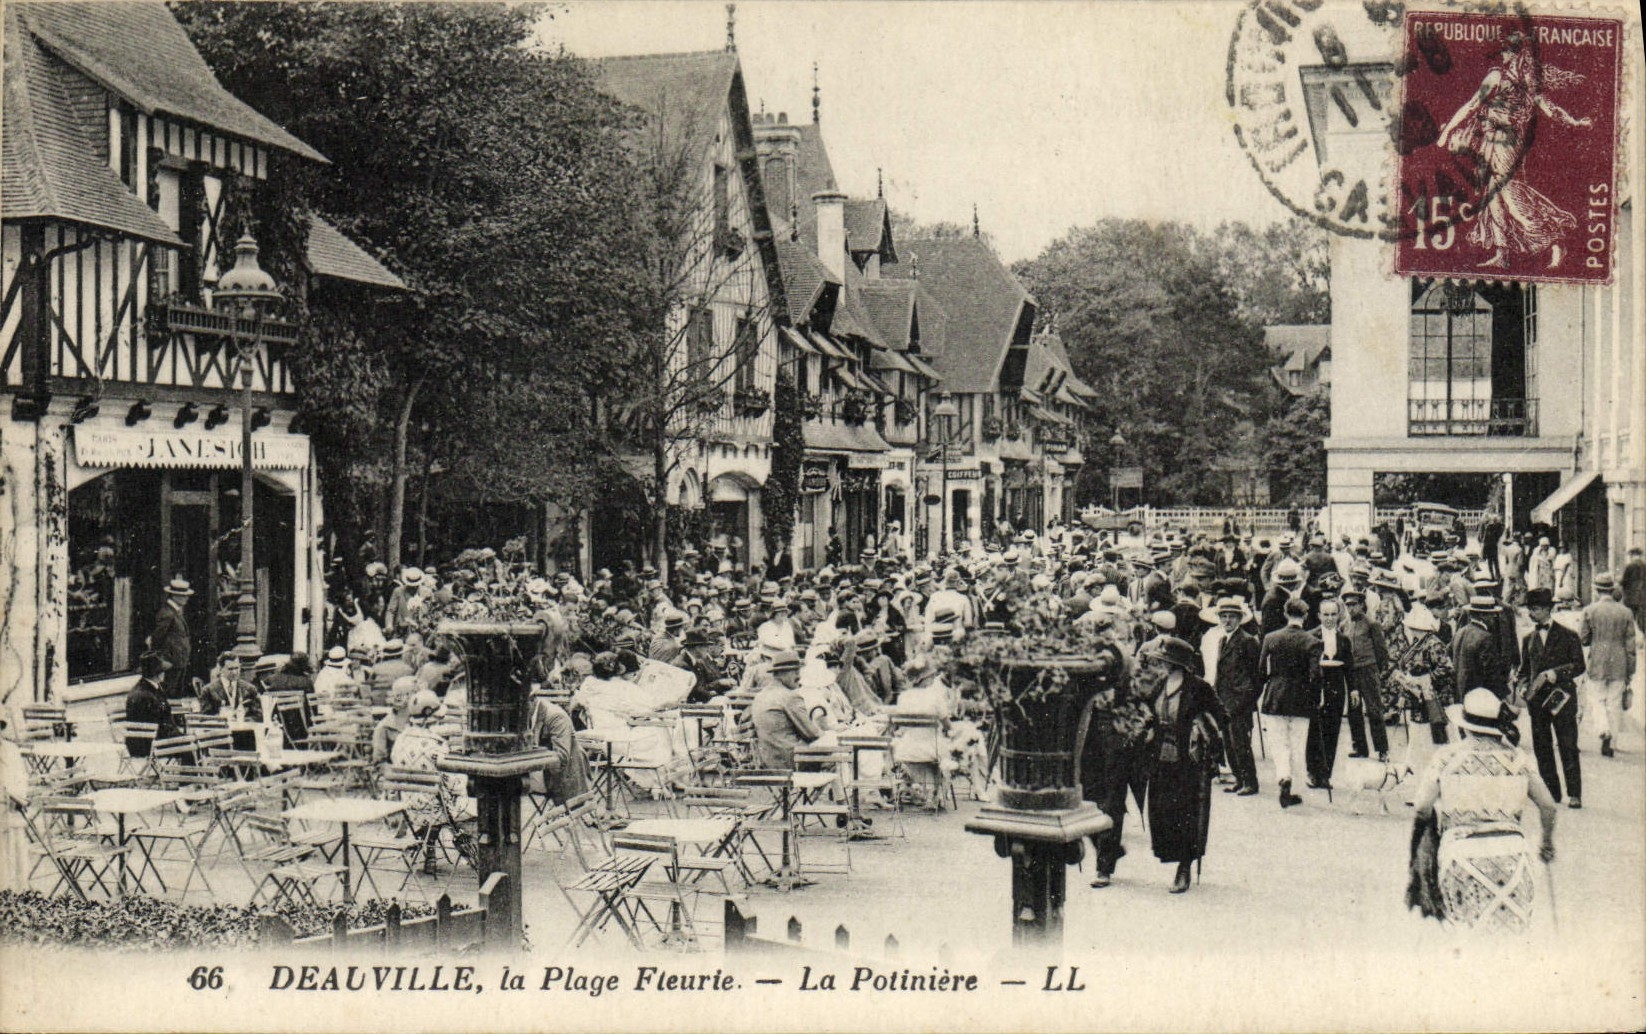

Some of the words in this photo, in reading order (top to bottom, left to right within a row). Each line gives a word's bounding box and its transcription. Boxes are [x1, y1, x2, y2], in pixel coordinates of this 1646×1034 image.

[1413, 21, 1503, 42] REPUBLIQUE
[1533, 25, 1613, 47] FRANÇAISE
[1586, 182, 1609, 268] POSTES
